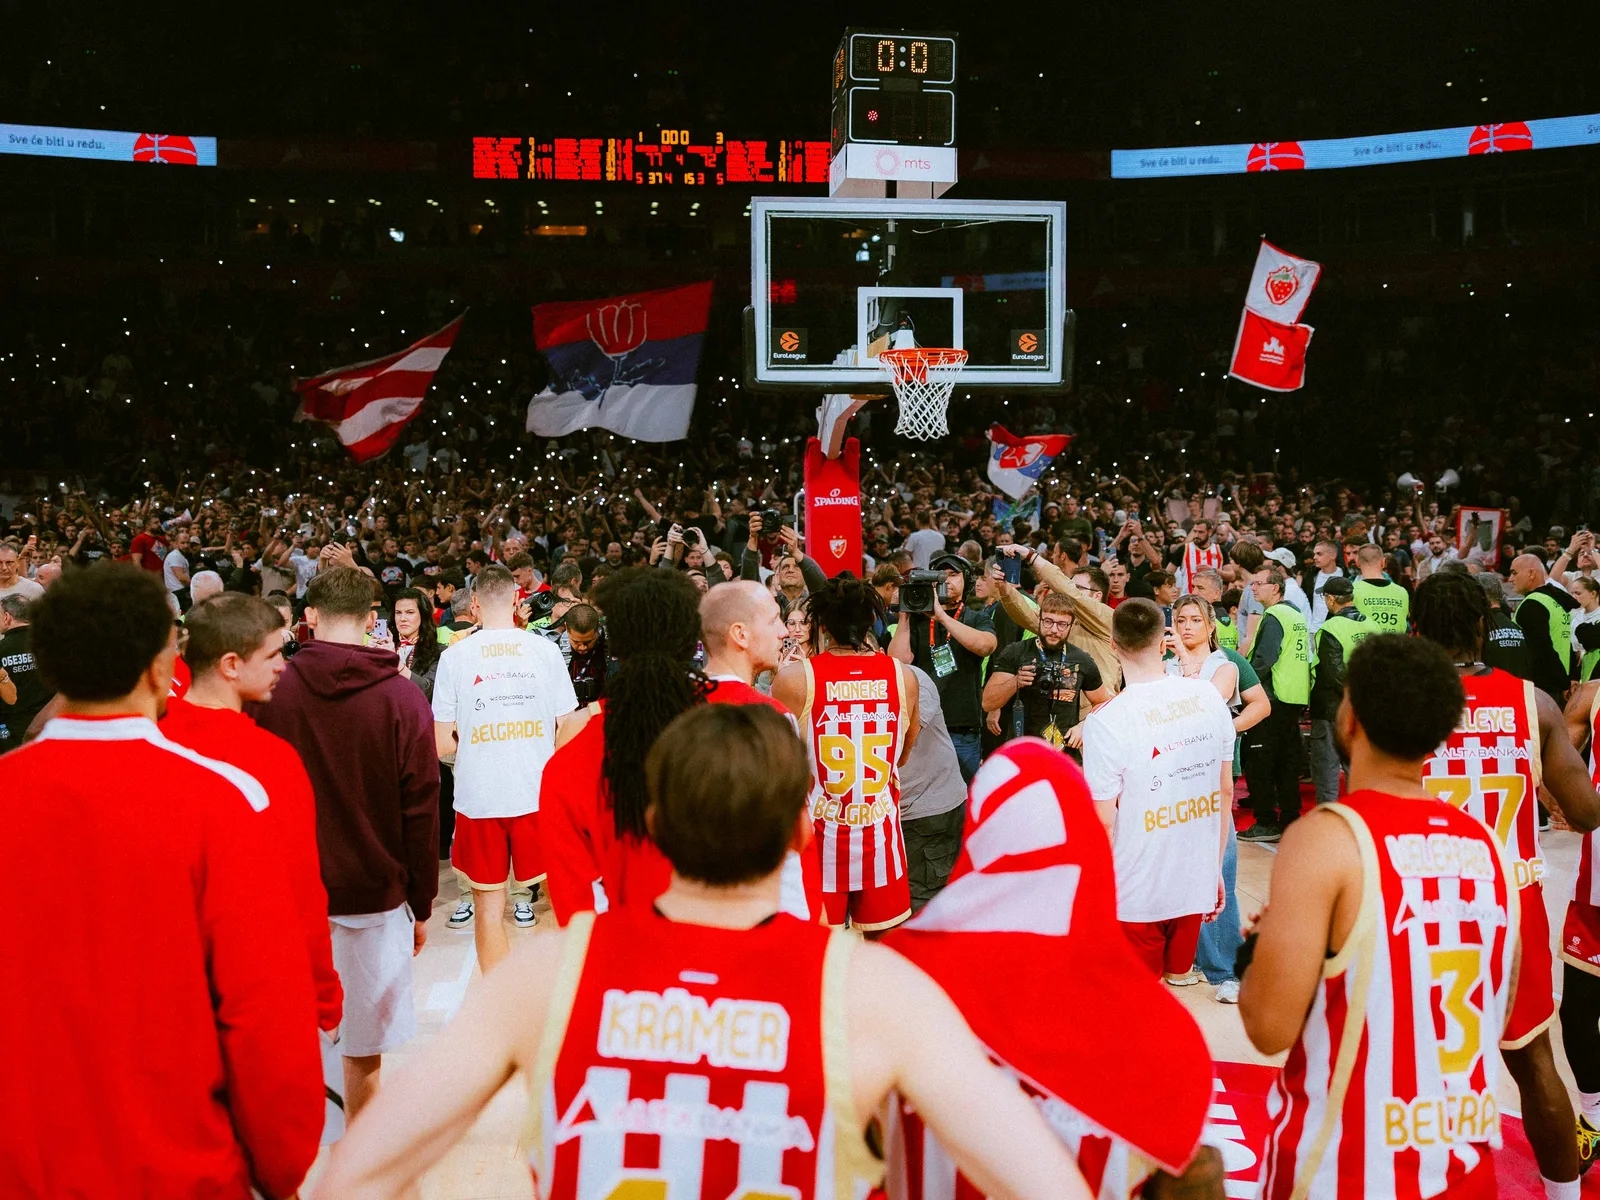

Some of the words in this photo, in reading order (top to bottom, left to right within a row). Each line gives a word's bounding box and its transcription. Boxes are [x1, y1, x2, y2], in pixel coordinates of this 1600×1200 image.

[9, 134, 28, 144] Sve
[46, 135, 65, 147] biti
[68, 140, 74, 148] u
[904, 156, 931, 170] mts
[814, 496, 860, 507] SPALDING
[1371, 611, 1398, 625] 295
[13, 663, 38, 673] SECUR
[826, 680, 888, 702] MONEKE
[1453, 707, 1516, 733] LEYE
[471, 720, 545, 745] BELGRADE
[818, 732, 893, 797] 95
[1427, 947, 1482, 1076] 3
